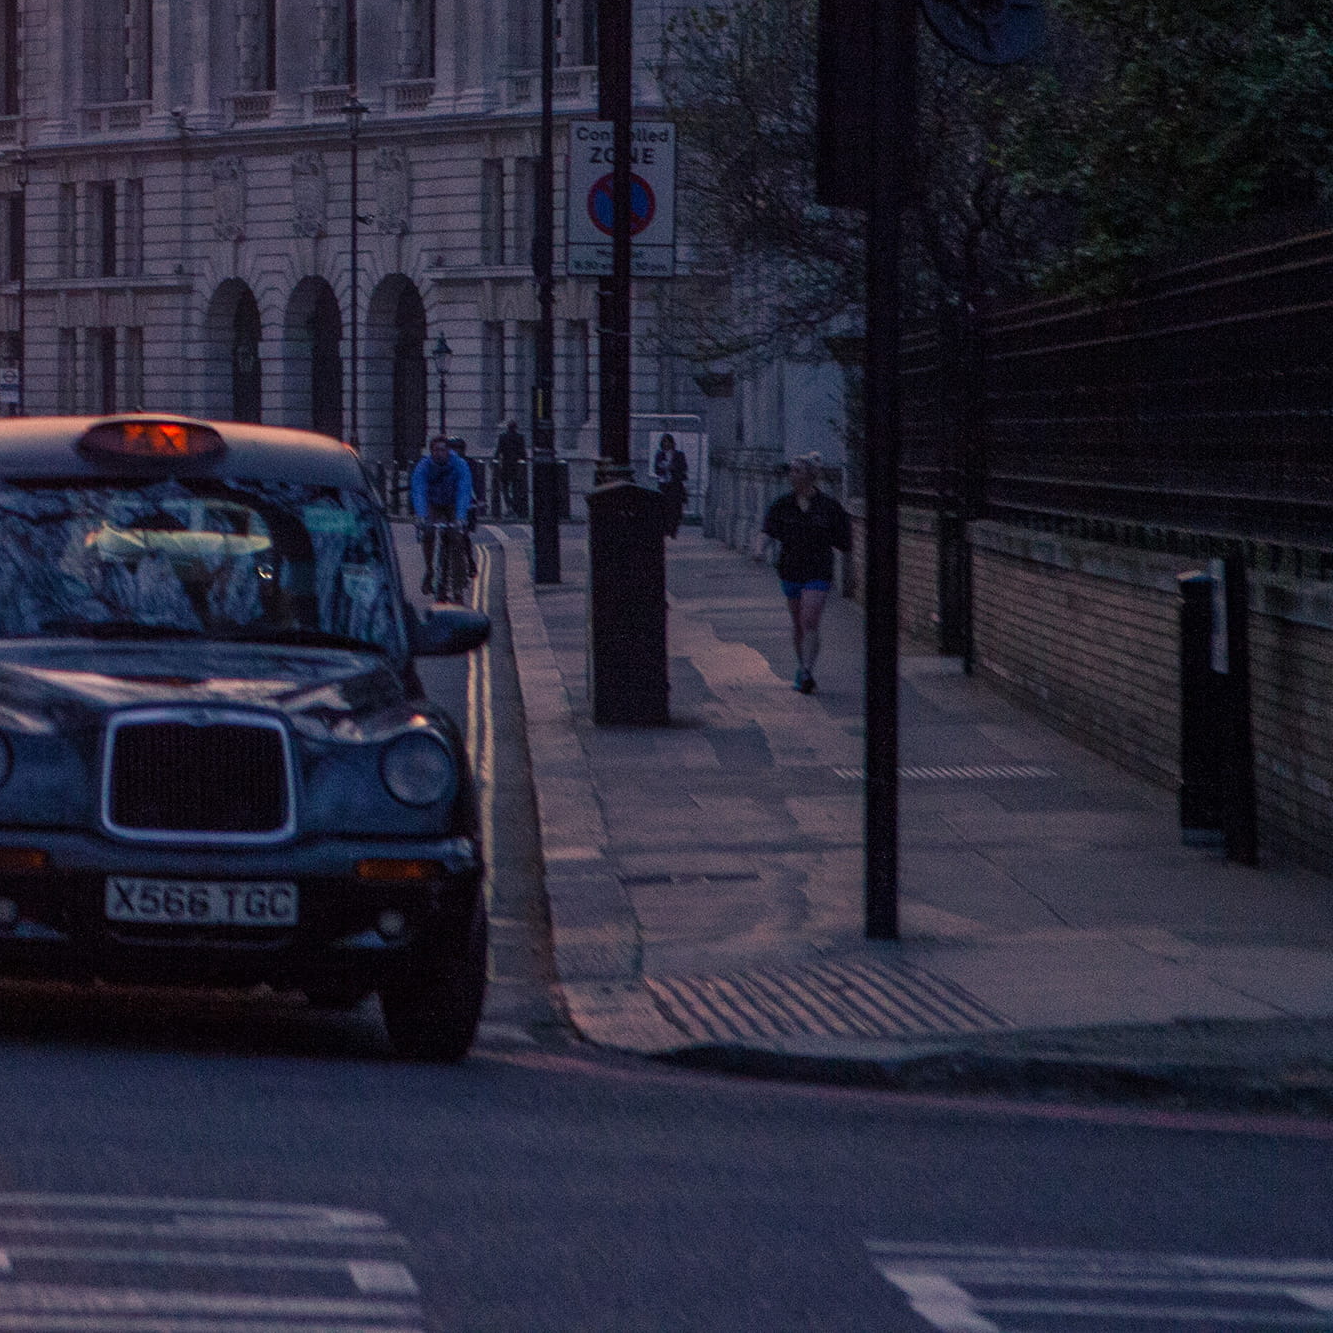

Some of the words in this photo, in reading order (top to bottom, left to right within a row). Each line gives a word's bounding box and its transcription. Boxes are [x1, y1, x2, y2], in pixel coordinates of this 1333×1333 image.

[576, 127, 669, 143] Conolled
[114, 880, 210, 918] X566
[221, 886, 292, 919] TGC
